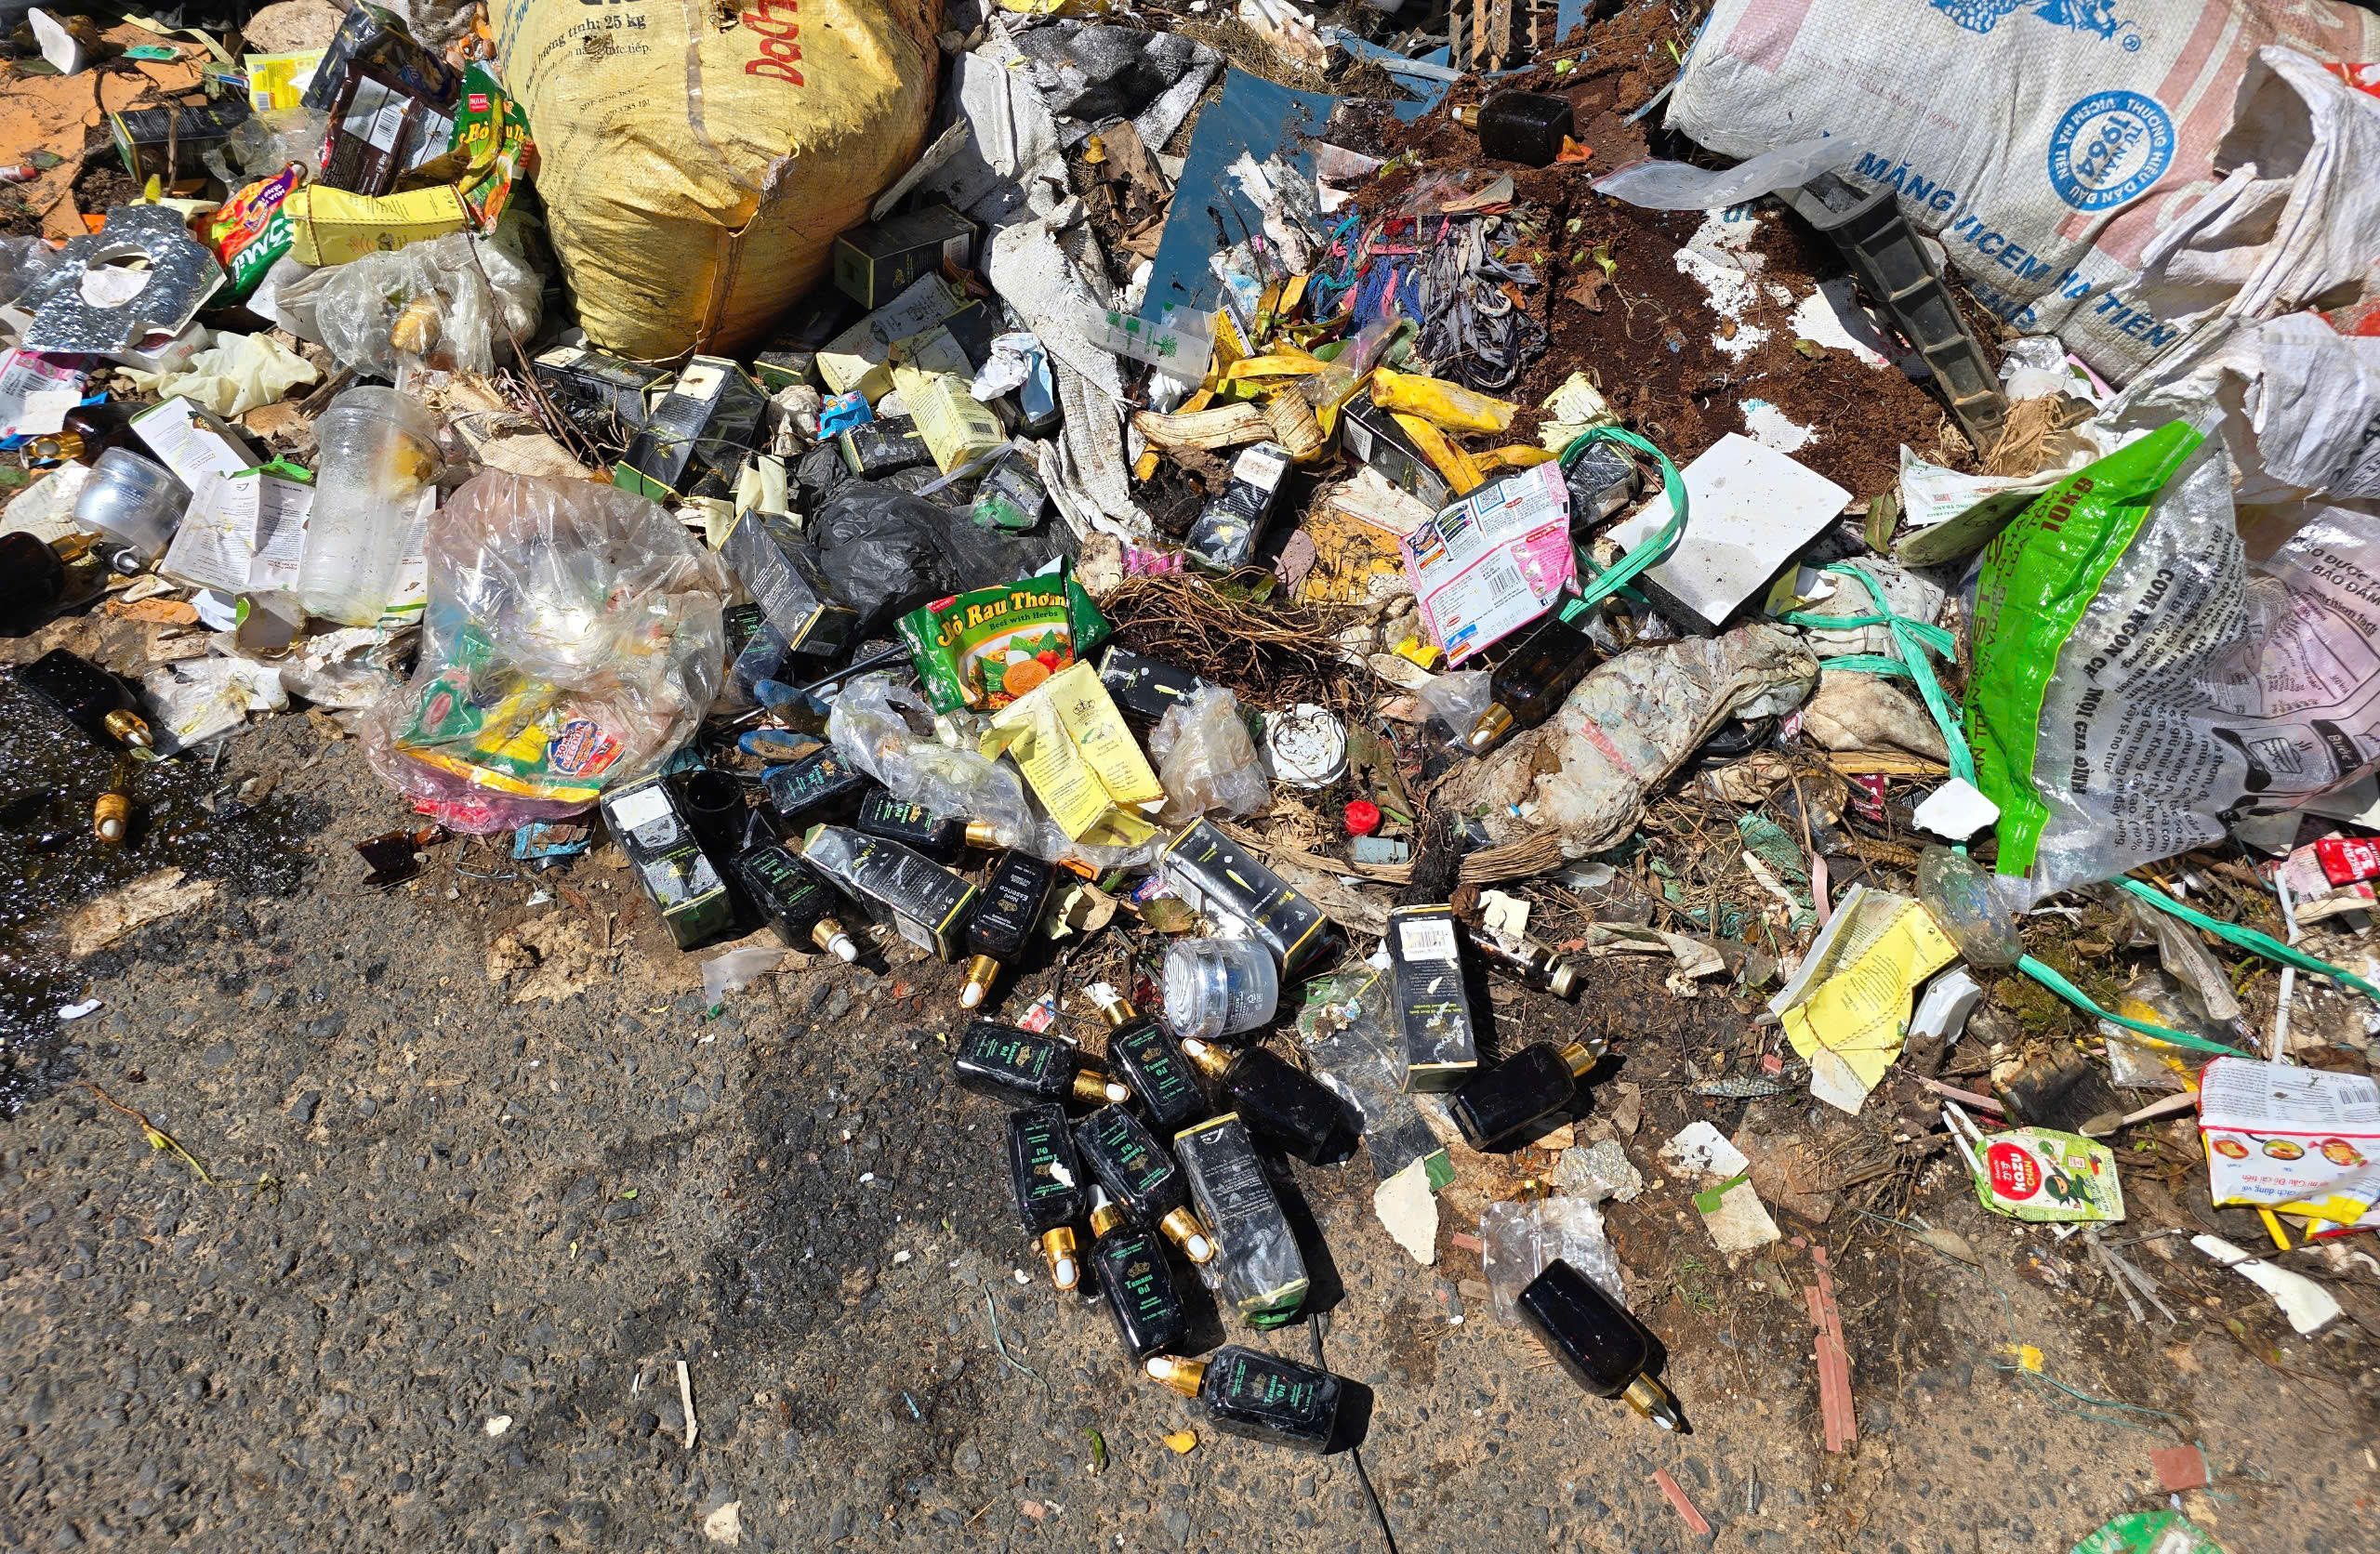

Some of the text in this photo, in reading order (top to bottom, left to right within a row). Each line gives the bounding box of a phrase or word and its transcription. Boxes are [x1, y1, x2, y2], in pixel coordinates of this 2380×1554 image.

[604, 15, 623, 30] 25
[626, 13, 647, 31] kg
[2074, 114, 2133, 179] 1964
[1853, 150, 1957, 214] MĂNG
[1953, 214, 2053, 284] VICEM
[2094, 290, 2181, 351] TIÊN
[937, 589, 1070, 648] Bò Rau Thơm
[988, 609, 1059, 631] Beef with Herbs
[2074, 688, 2106, 718] MỌI
[561, 723, 586, 770] ACECOOK
[2135, 737, 2162, 775] Không
[2115, 745, 2141, 782] trong
[2071, 756, 2096, 796] ĐÌNH
[2145, 827, 2157, 853] cơm
[999, 885, 1029, 902] Essence
[999, 1044, 1010, 1057] Oil
[1005, 1041, 1022, 1065] Tamanu
[1143, 1057, 1170, 1073] Tamanu
[1155, 1067, 1169, 1077] Oil
[1035, 1147, 1050, 1156] Oil
[1120, 1142, 1134, 1154] Oil
[1120, 1144, 1146, 1165] Tamanu
[2024, 1160, 2036, 1187] CHAN
[2254, 1184, 2275, 1196] dùng
[1124, 1274, 1154, 1290] Tamanu
[1137, 1284, 1151, 1297] Oil
[1263, 1374, 1278, 1405] Tamanu
[1276, 1382, 1288, 1399] Oil
